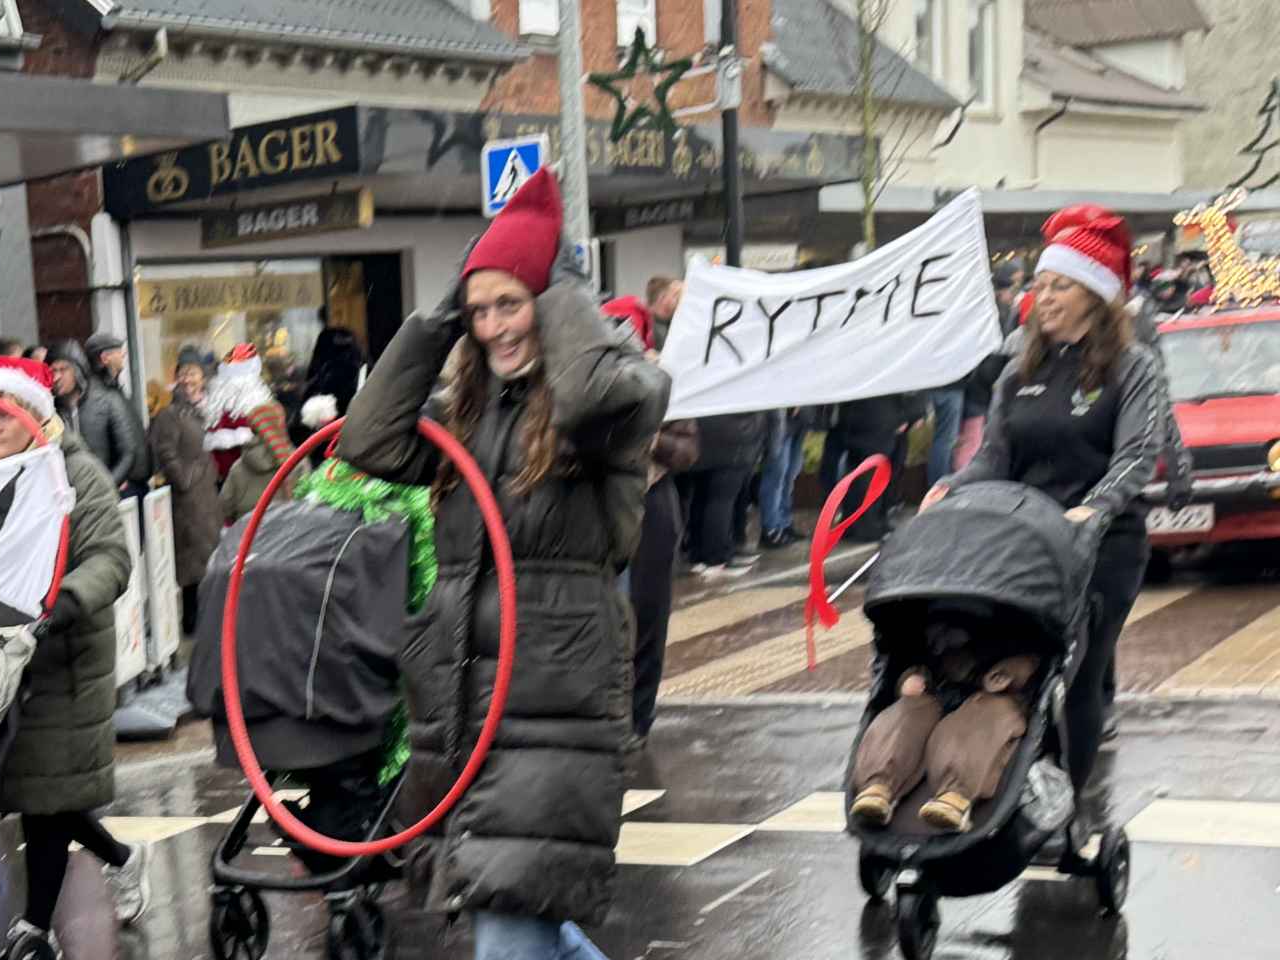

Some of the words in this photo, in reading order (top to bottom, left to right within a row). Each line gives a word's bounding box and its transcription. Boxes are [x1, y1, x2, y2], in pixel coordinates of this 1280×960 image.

[208, 119, 344, 187] BAGER
[237, 203, 320, 237] BAGER
[704, 253, 956, 367] RYTME
